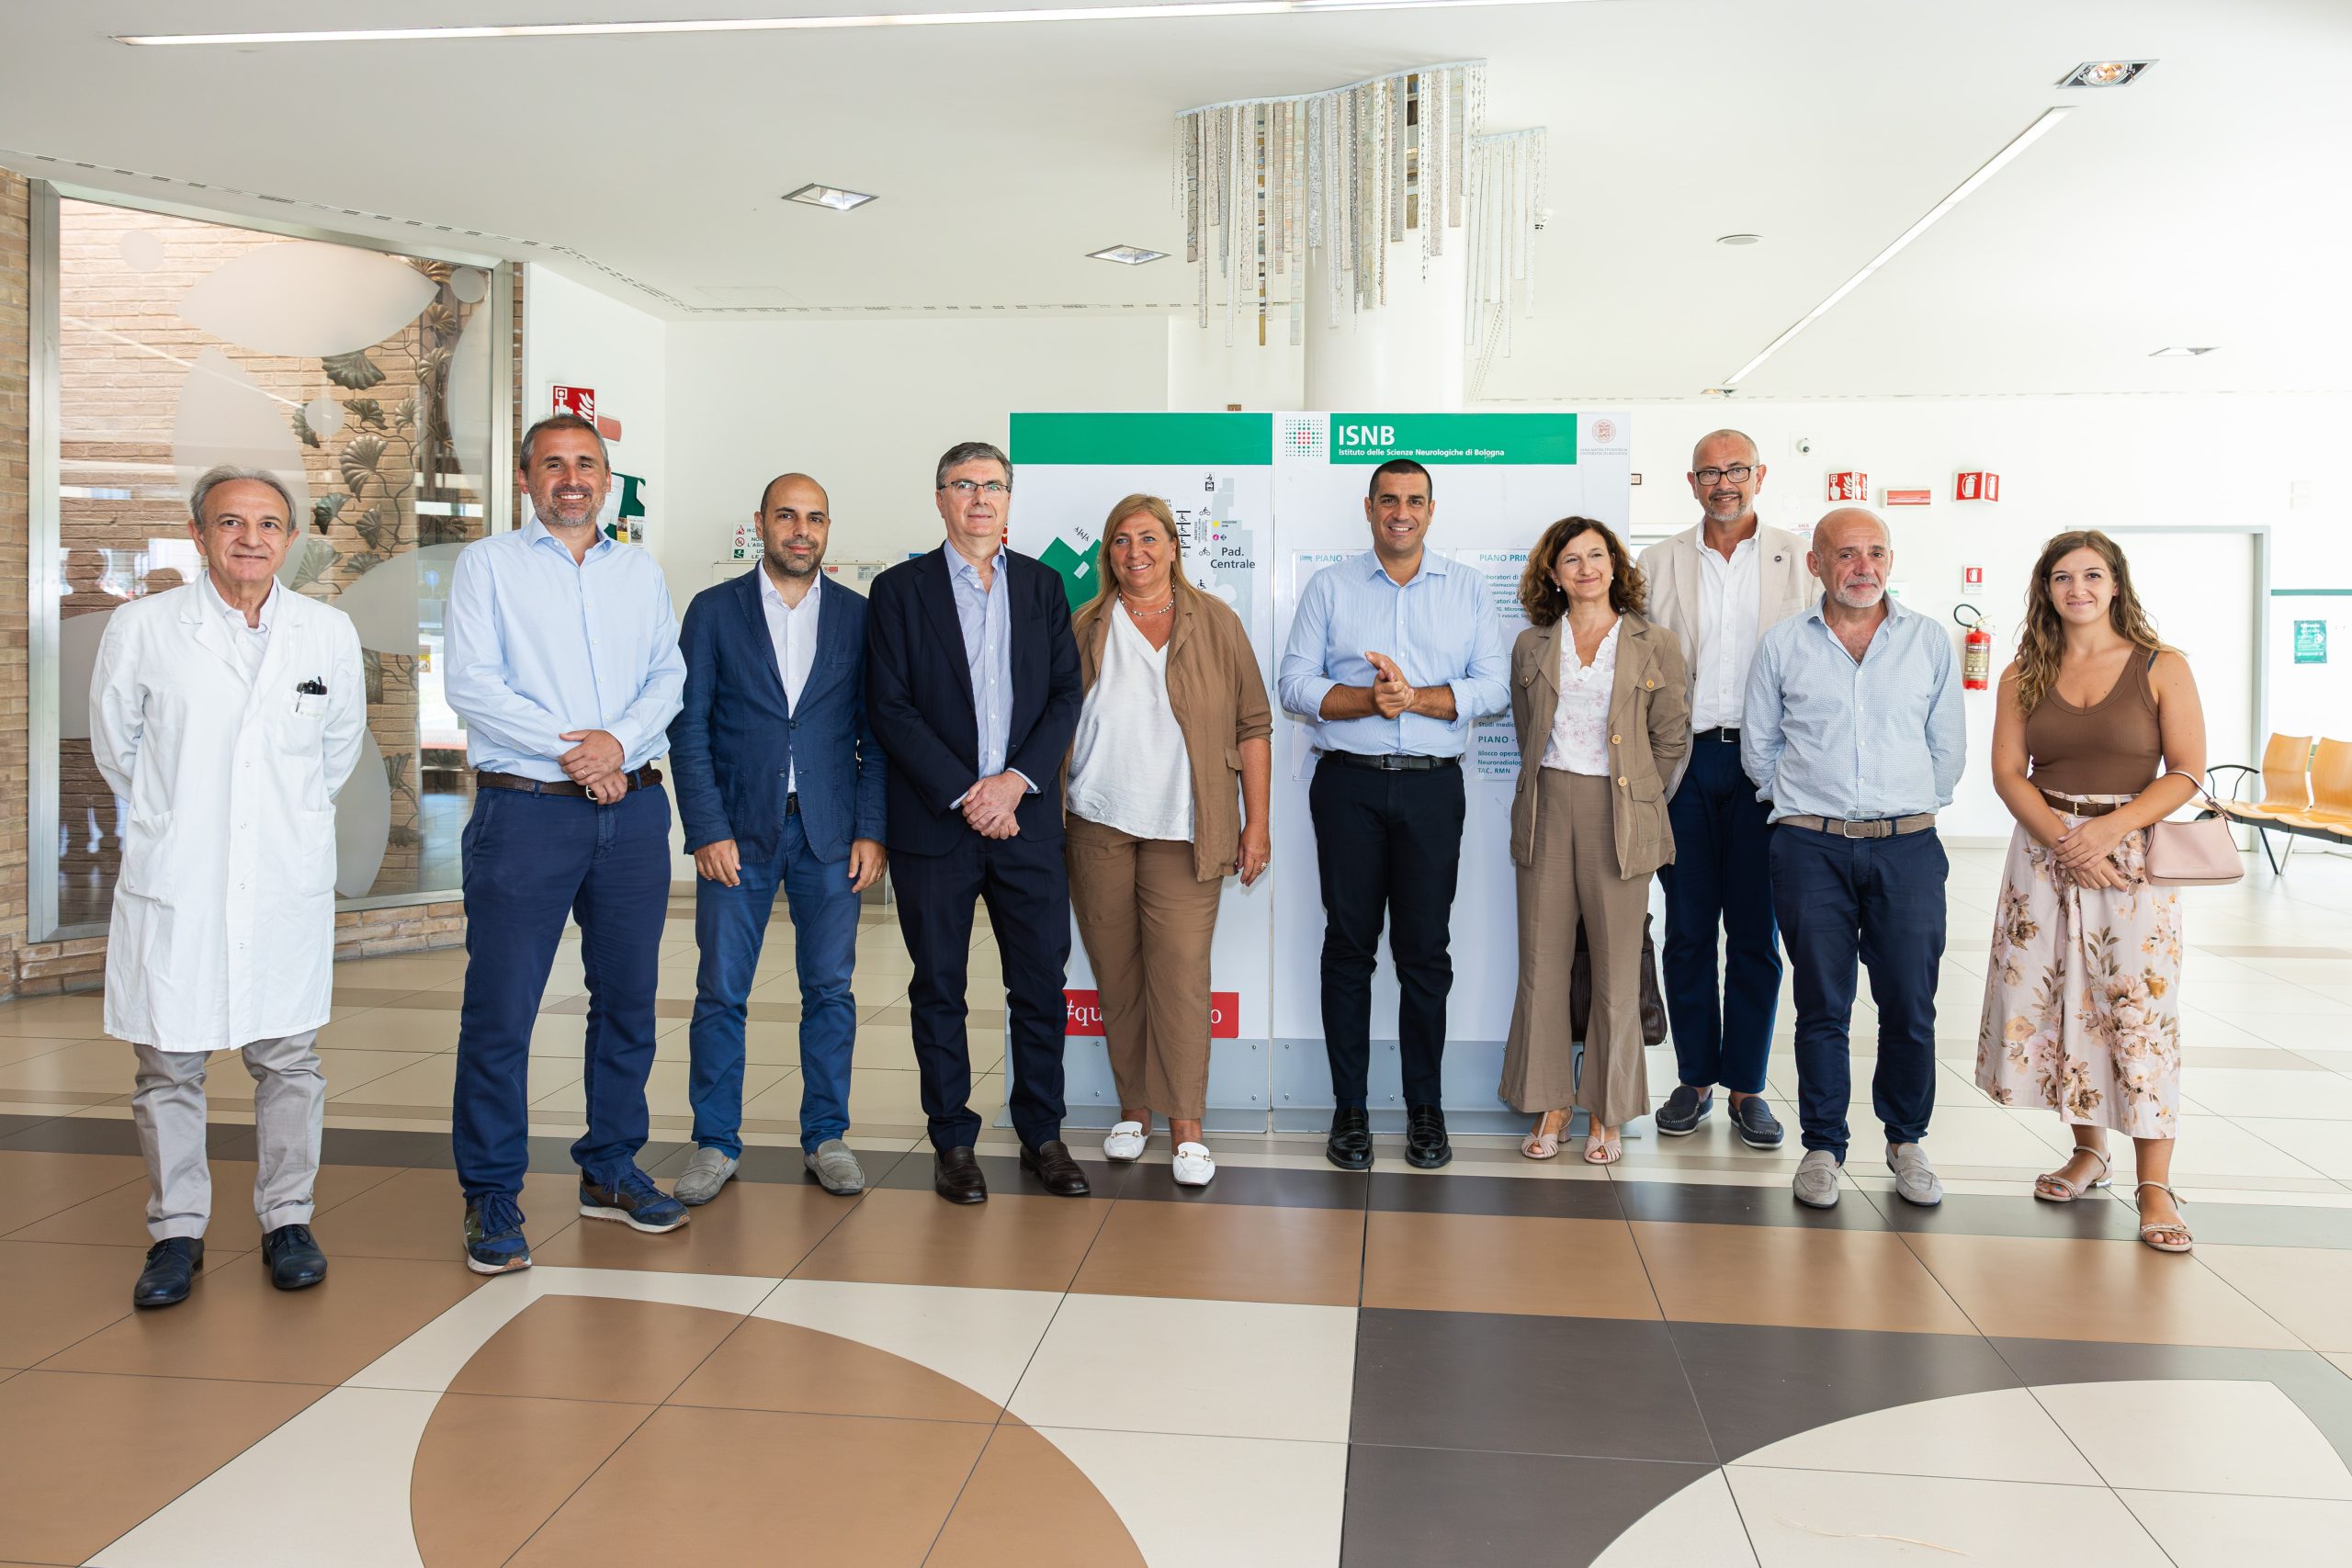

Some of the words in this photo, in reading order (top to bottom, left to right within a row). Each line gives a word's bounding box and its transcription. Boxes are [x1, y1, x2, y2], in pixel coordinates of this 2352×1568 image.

[1339, 425, 1396, 446] ISNB
[1415, 448, 1464, 457] Neurologiche
[1475, 448, 1504, 457] Bologna
[1221, 547, 1245, 557] Pad.
[1479, 554, 1507, 562] PIANO
[1210, 558, 1256, 569] Centrale
